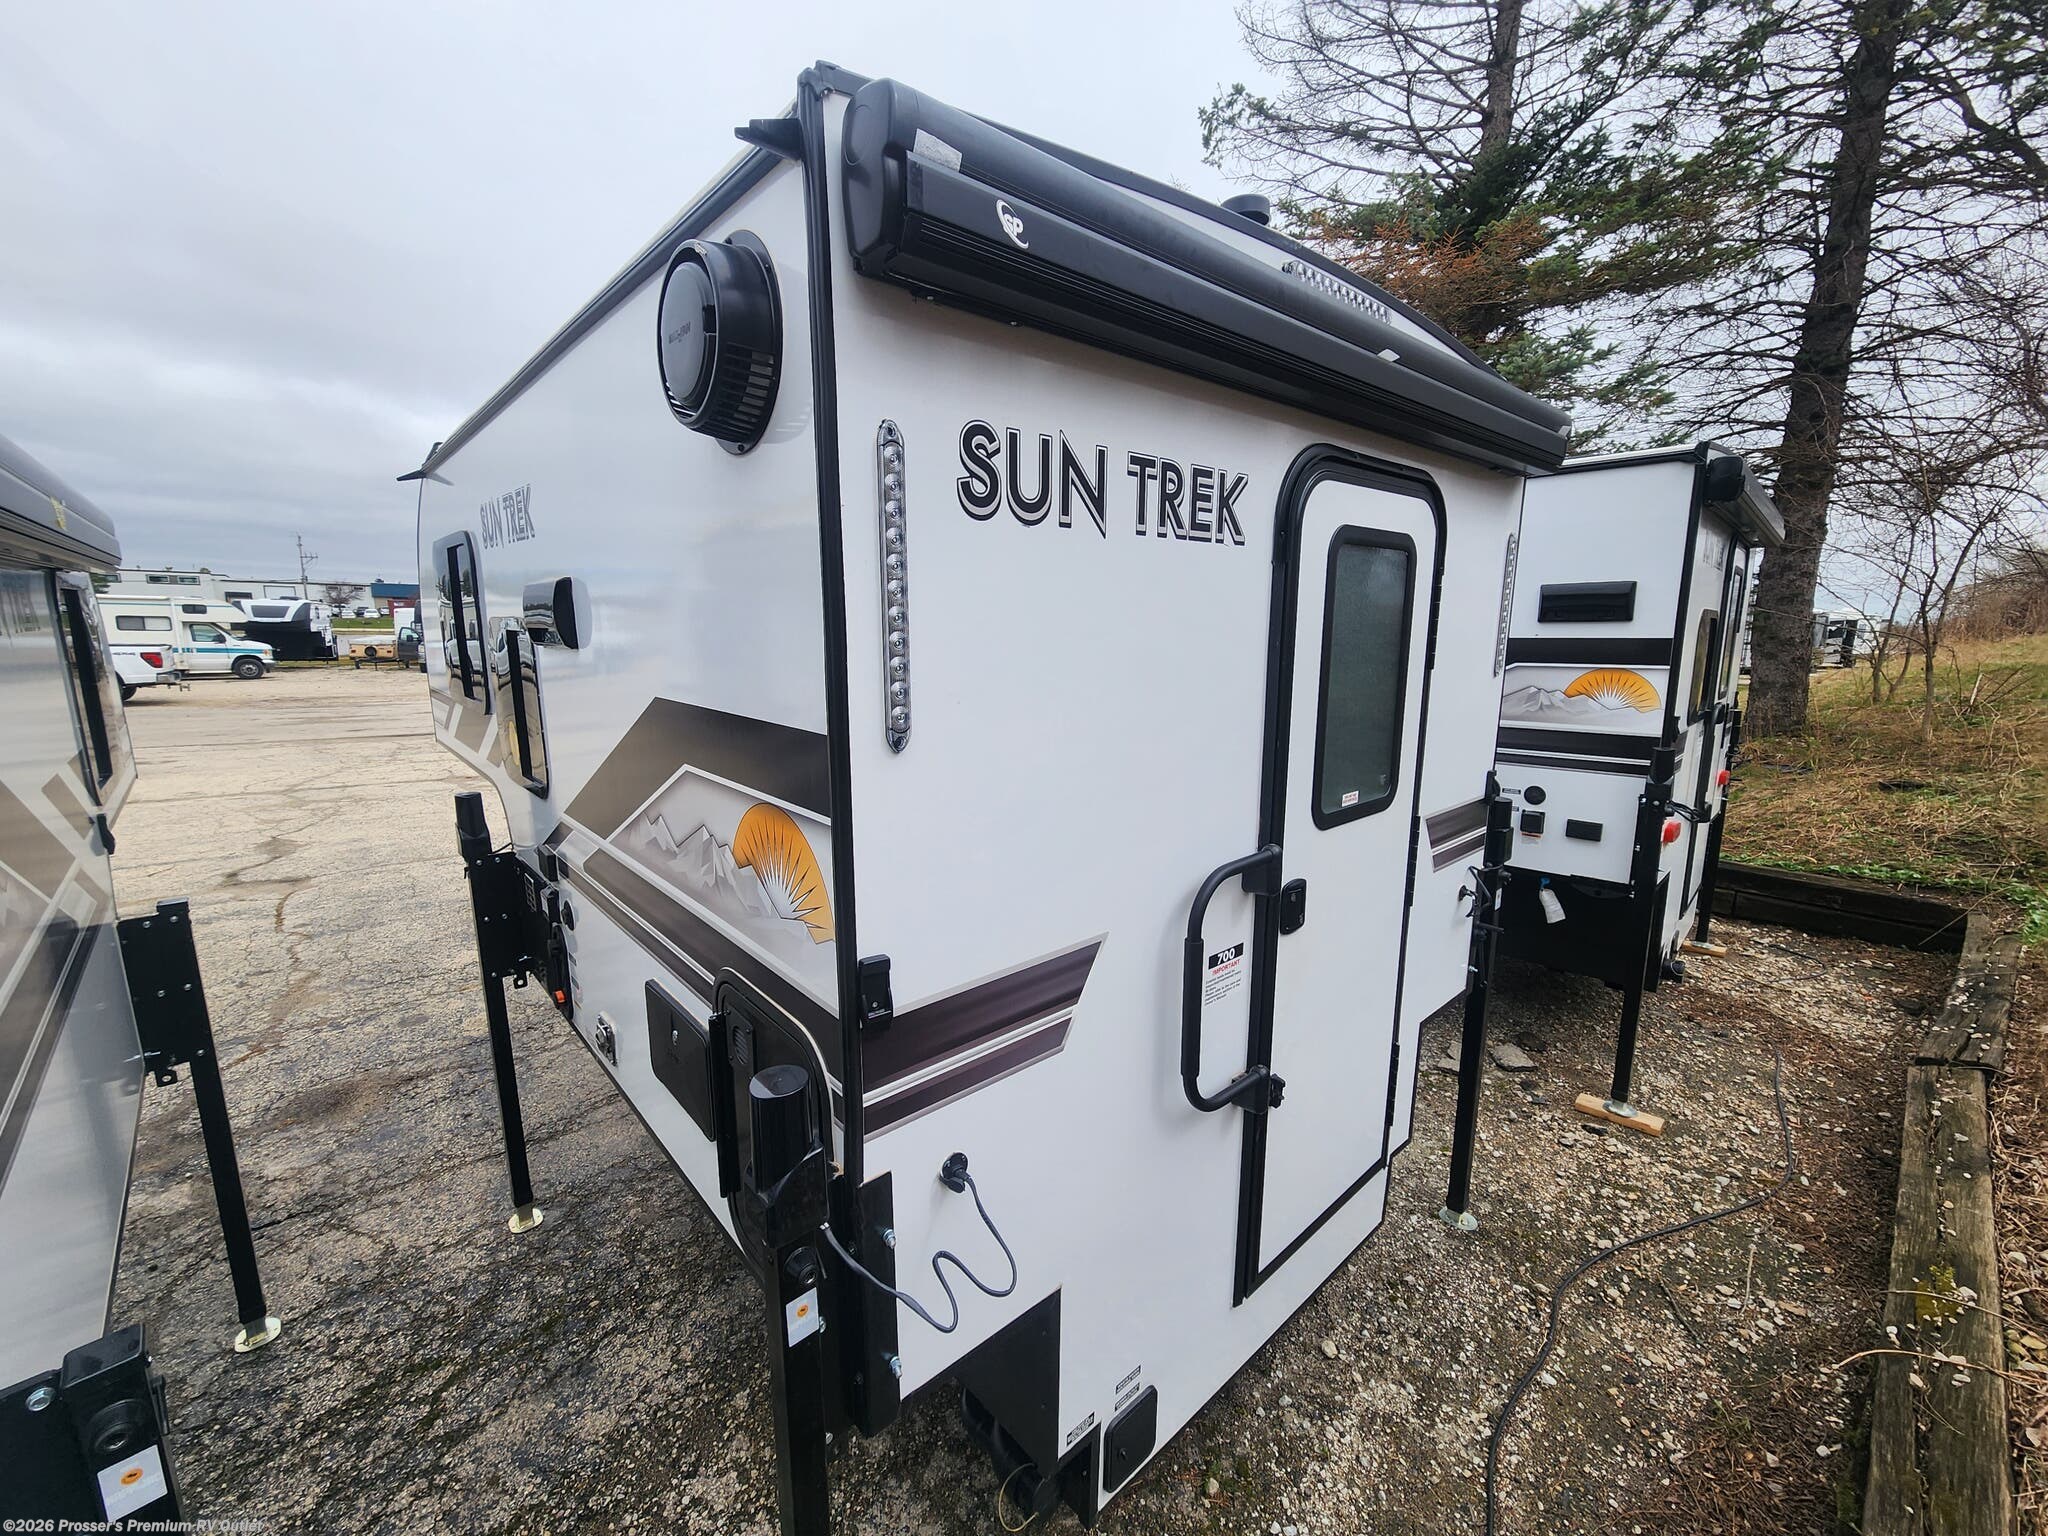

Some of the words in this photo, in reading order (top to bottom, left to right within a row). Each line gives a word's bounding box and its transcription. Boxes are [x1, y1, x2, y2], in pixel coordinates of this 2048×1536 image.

[957, 419, 1109, 540] SUN
[1127, 450, 1249, 546] TREK
[480, 497, 505, 550] SUN
[502, 483, 536, 544] TREK
[1212, 958, 1241, 975] IMPORTANT
[1217, 947, 1236, 966] 700
